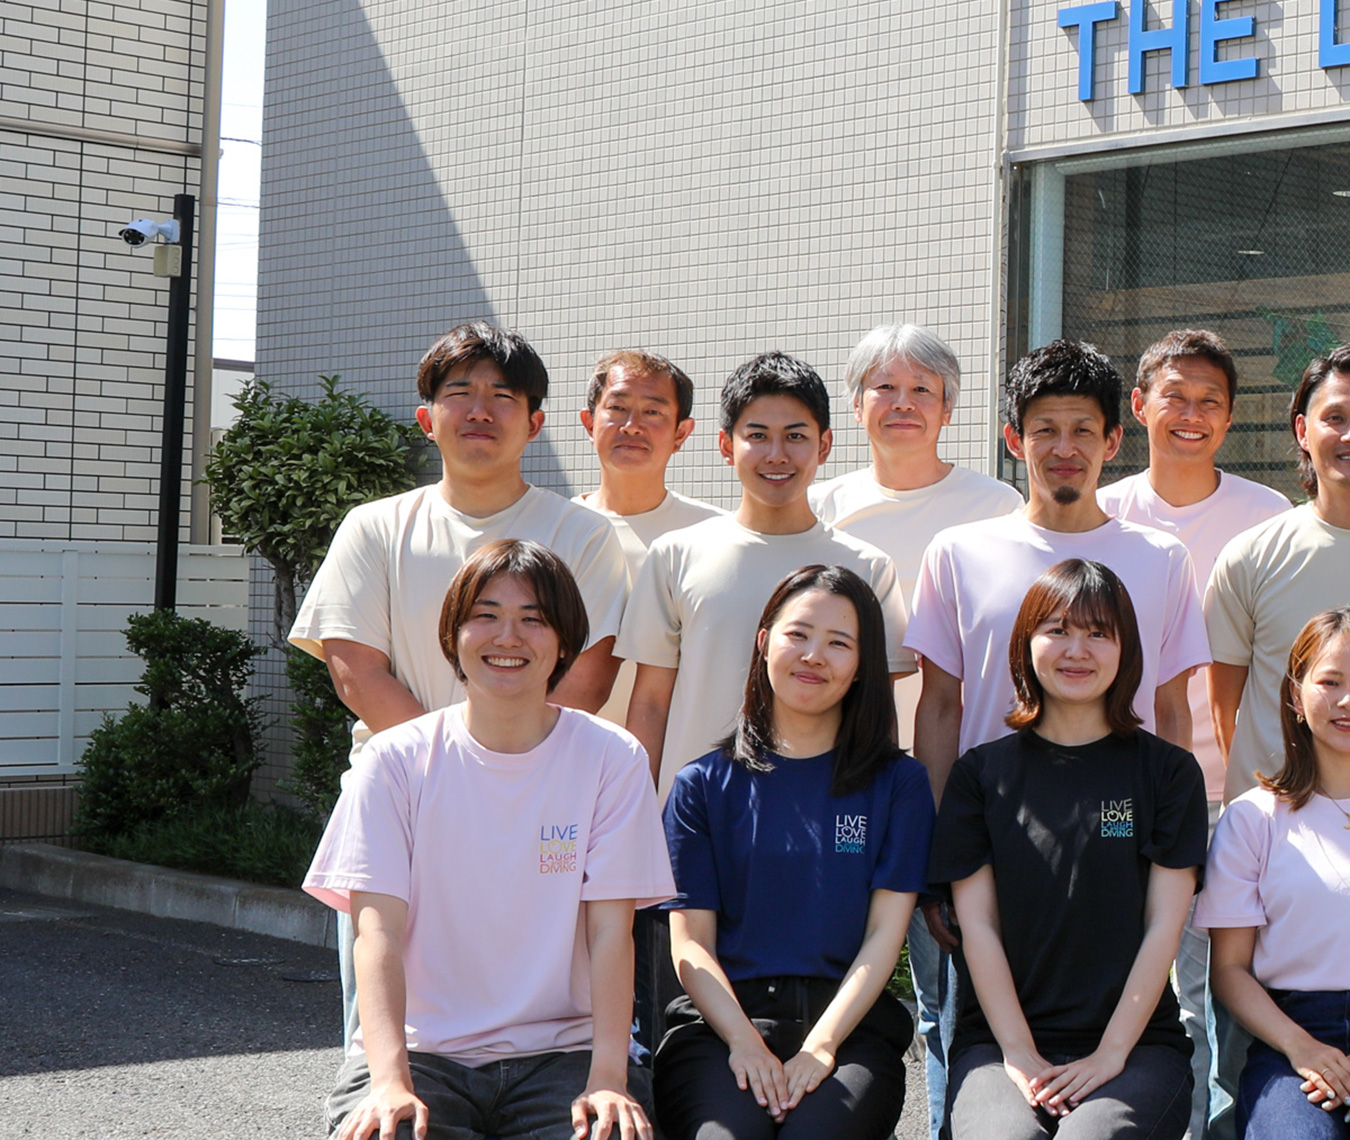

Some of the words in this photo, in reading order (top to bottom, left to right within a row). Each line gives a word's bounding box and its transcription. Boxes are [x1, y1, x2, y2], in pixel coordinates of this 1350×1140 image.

[1058, 0, 1260, 101] THE
[1101, 798, 1133, 811] LIVE
[836, 814, 867, 829] LIVE
[1101, 810, 1133, 822] LOVE
[1101, 821, 1134, 829] LAUGH
[540, 824, 578, 841] LIVE
[835, 826, 866, 839] LOVE
[1101, 828, 1134, 838] DIVING
[540, 840, 577, 854] LOVE
[835, 837, 865, 846] LAUGH
[540, 852, 577, 863] LAUGH
[540, 861, 577, 874] DIVING
